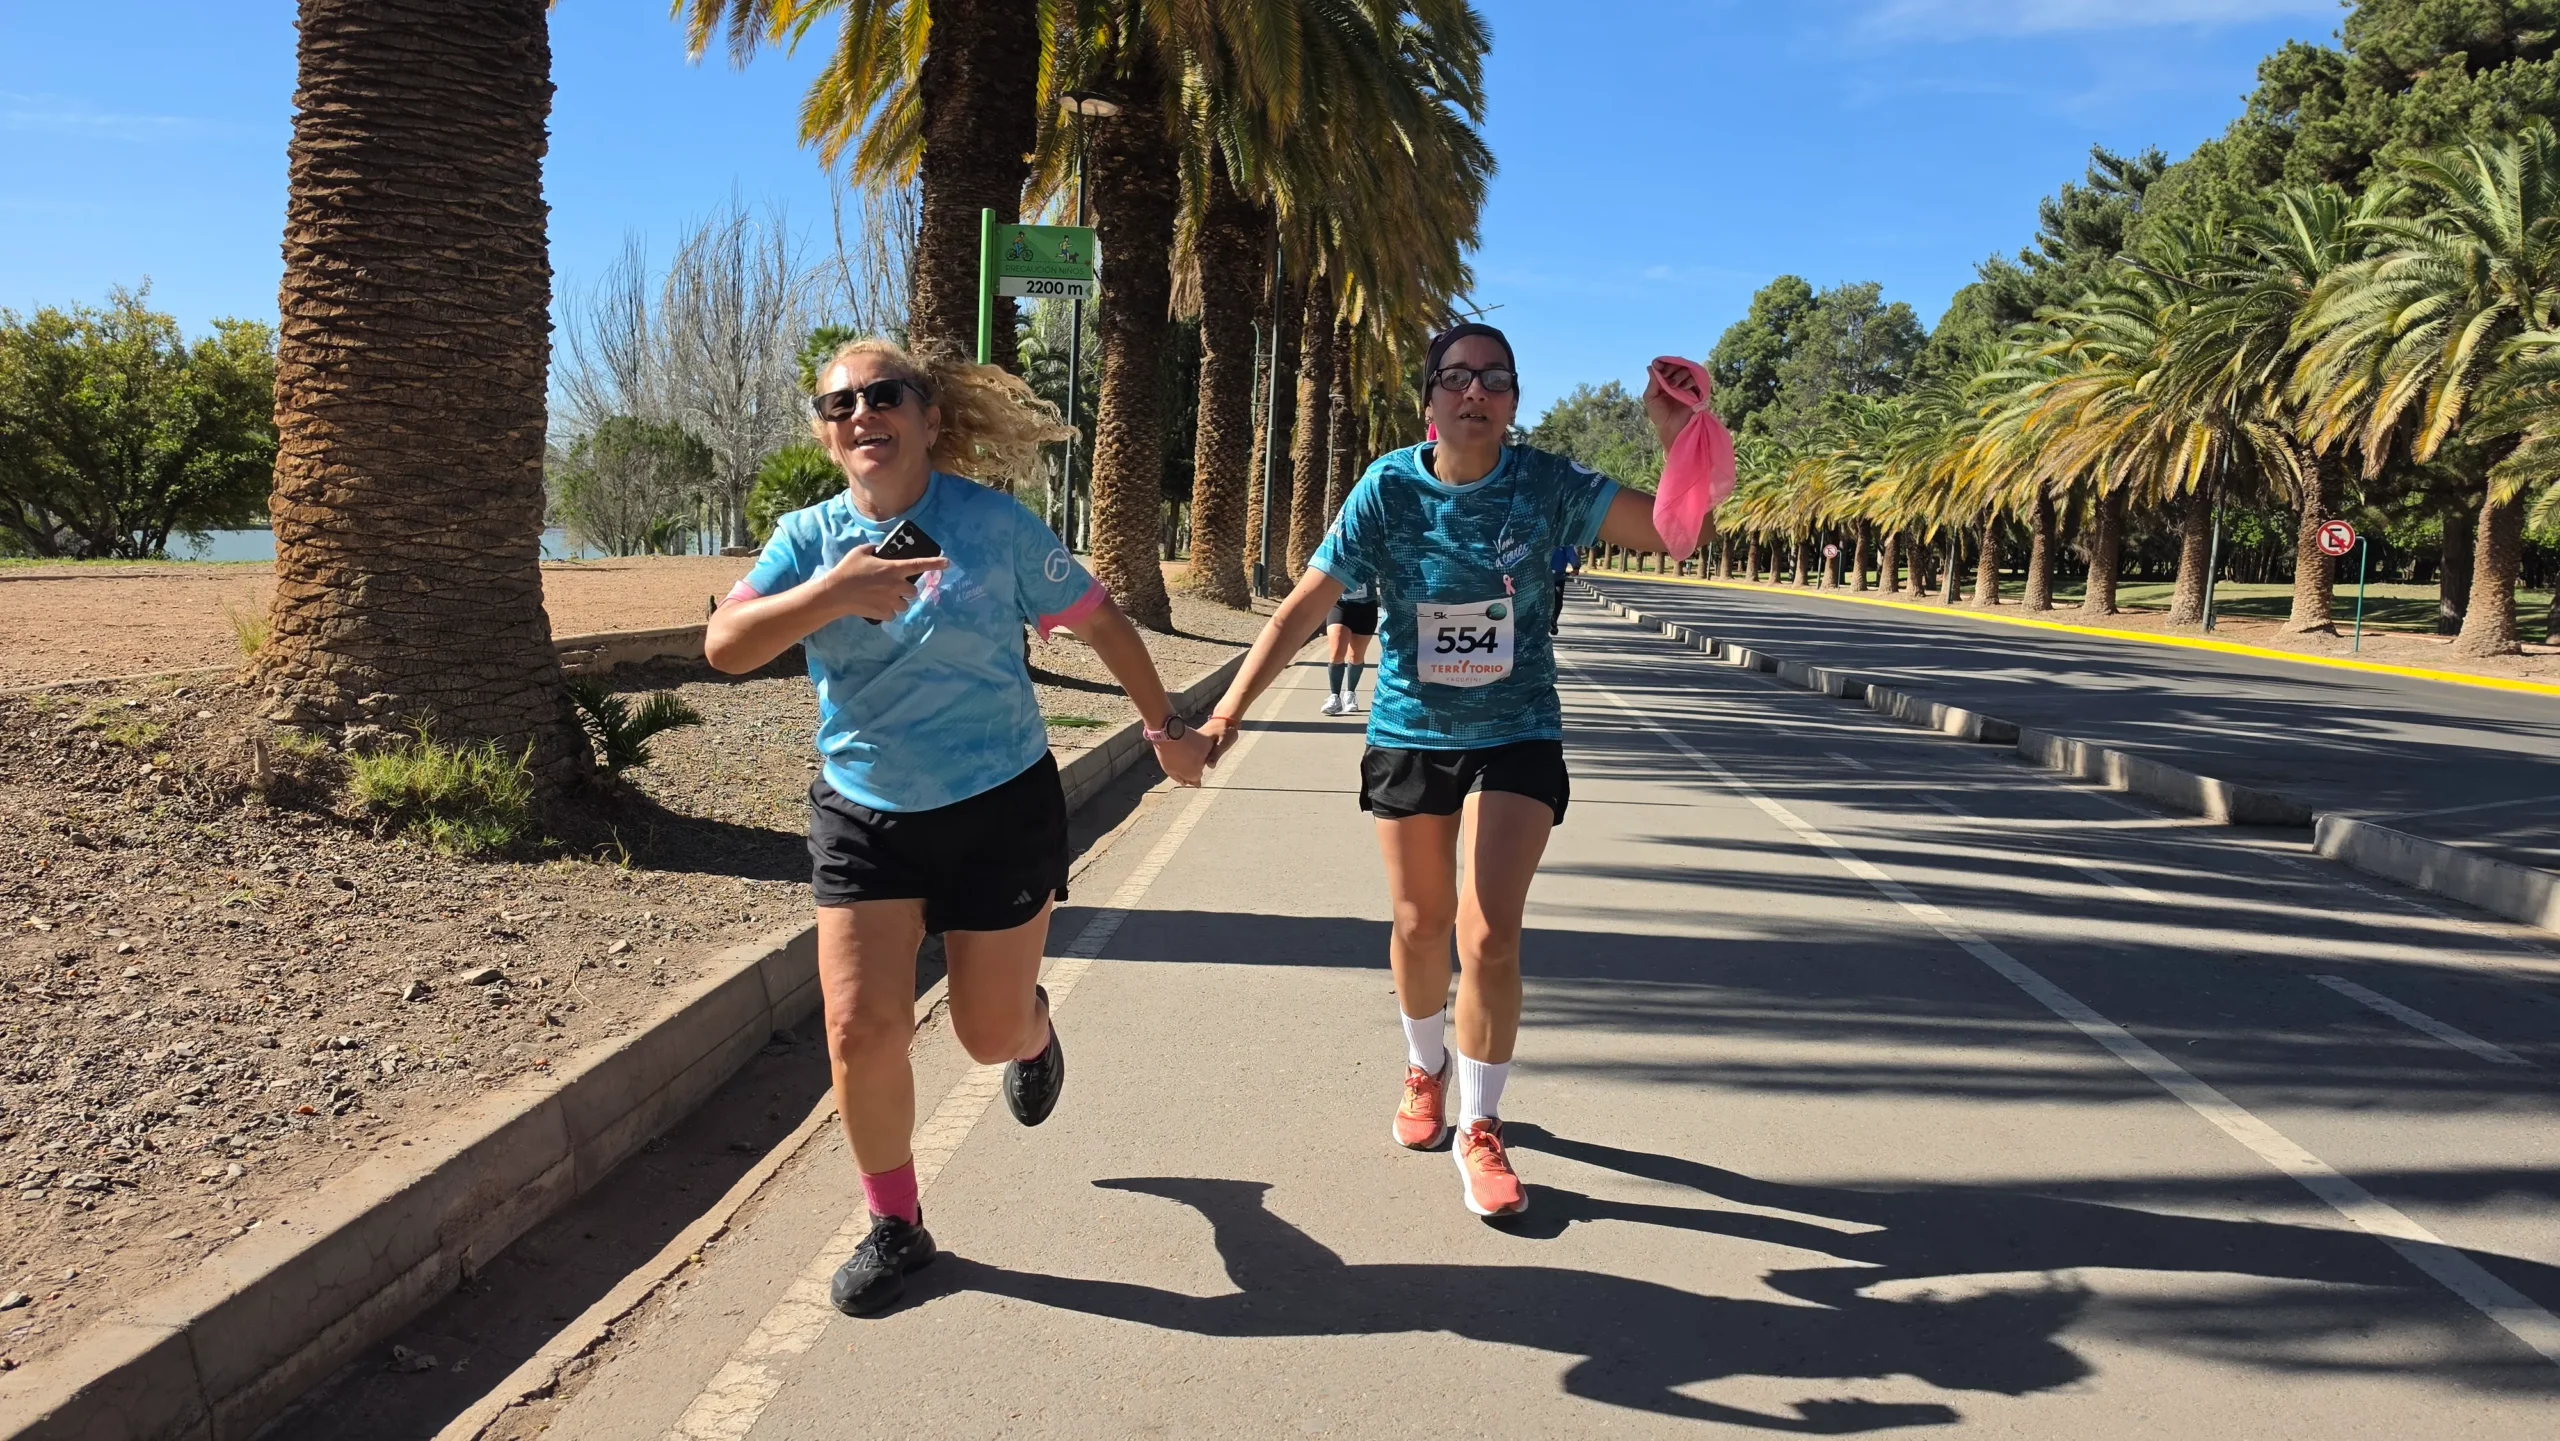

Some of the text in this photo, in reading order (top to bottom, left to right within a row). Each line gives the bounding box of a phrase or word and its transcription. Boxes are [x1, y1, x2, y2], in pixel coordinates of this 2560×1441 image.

[1005, 264, 1085, 275] PRECAUCIÓN NIÑOS
[1026, 280, 1083, 295] 2200 m
[1433, 611, 1448, 620] 5k
[1434, 626, 1499, 654] 554
[1431, 659, 1504, 674] TERRITORIO
